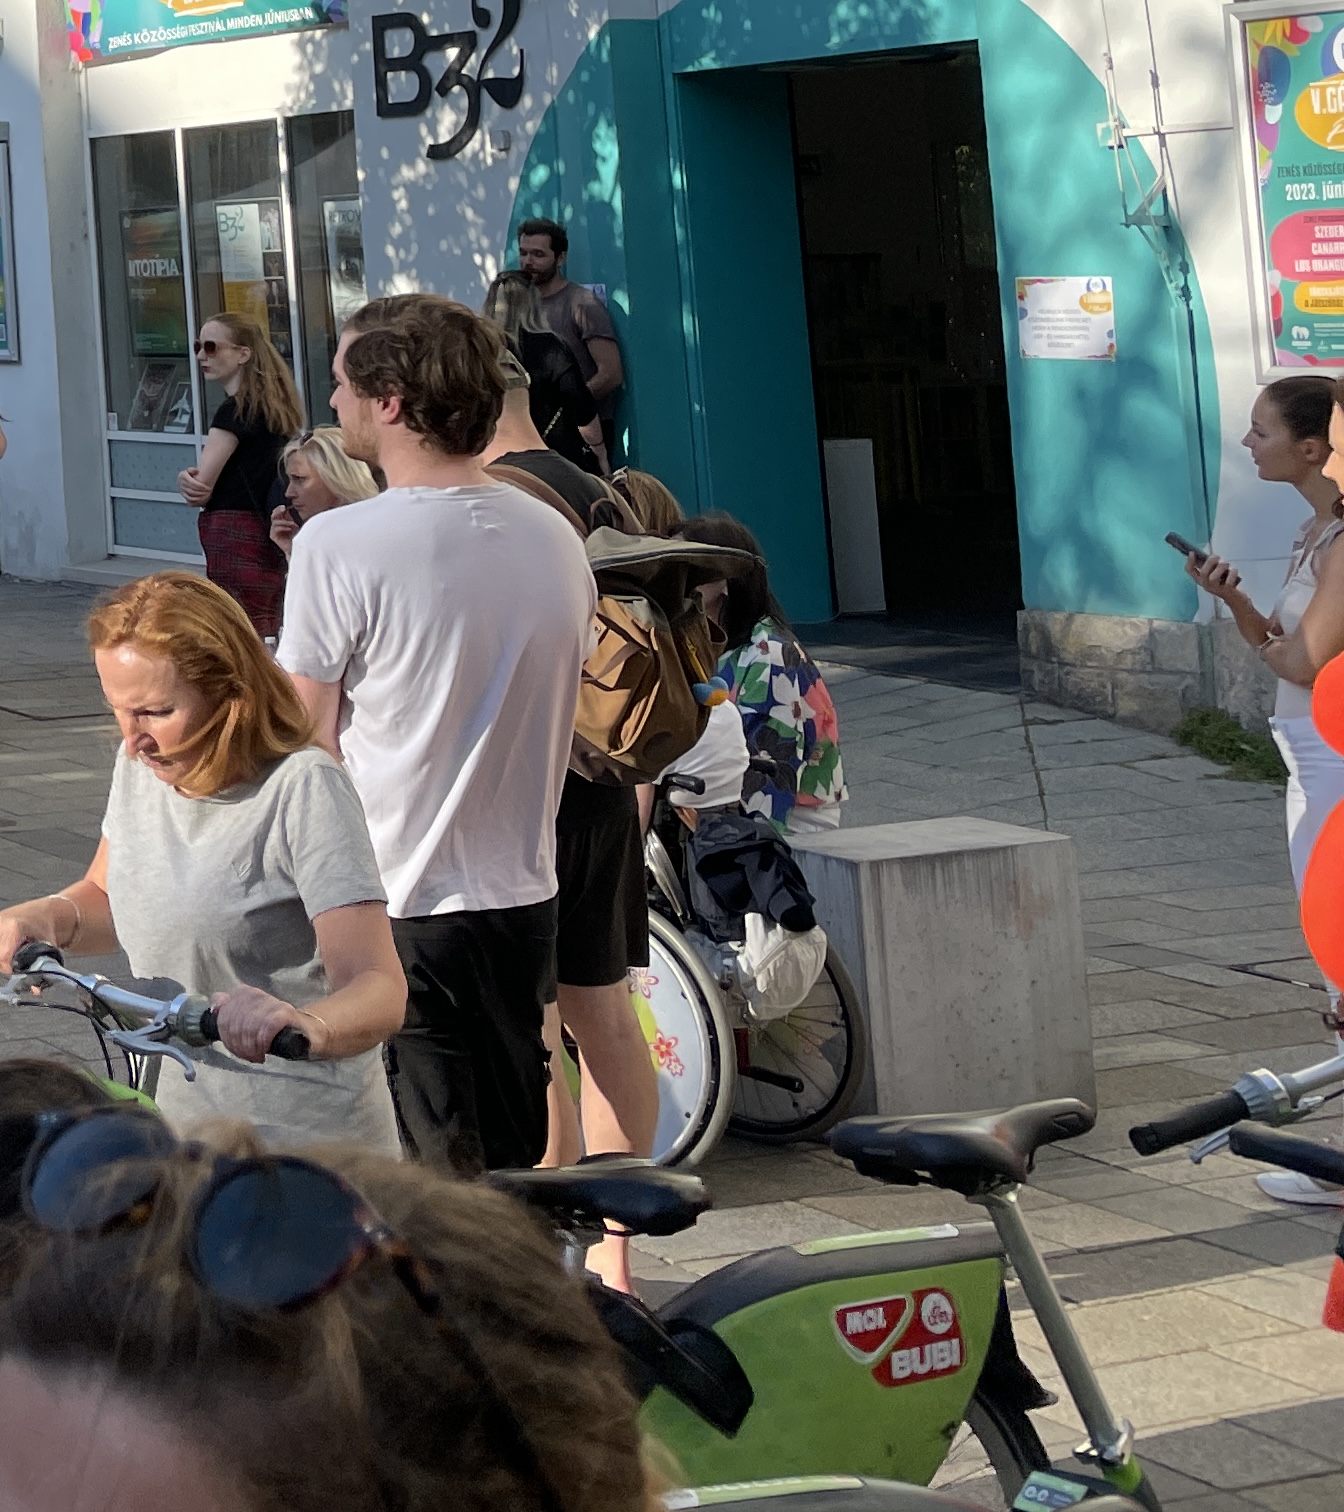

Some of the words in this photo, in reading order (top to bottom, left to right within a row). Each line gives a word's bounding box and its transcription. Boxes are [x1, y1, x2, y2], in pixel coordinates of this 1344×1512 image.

[108, 32, 133, 50] ZENÉS
[187, 18, 226, 37] FESZTIVÁL
[226, 14, 263, 30] MINDEN
[263, 6, 314, 25] JÚNIUSBAN
[1277, 165, 1301, 179] ZENÉS
[1285, 183, 1320, 201] 2023.
[219, 206, 245, 241] B32
[1295, 259, 1311, 273] LOS
[846, 1307, 887, 1335] MOL
[891, 1338, 961, 1380] BUBI
